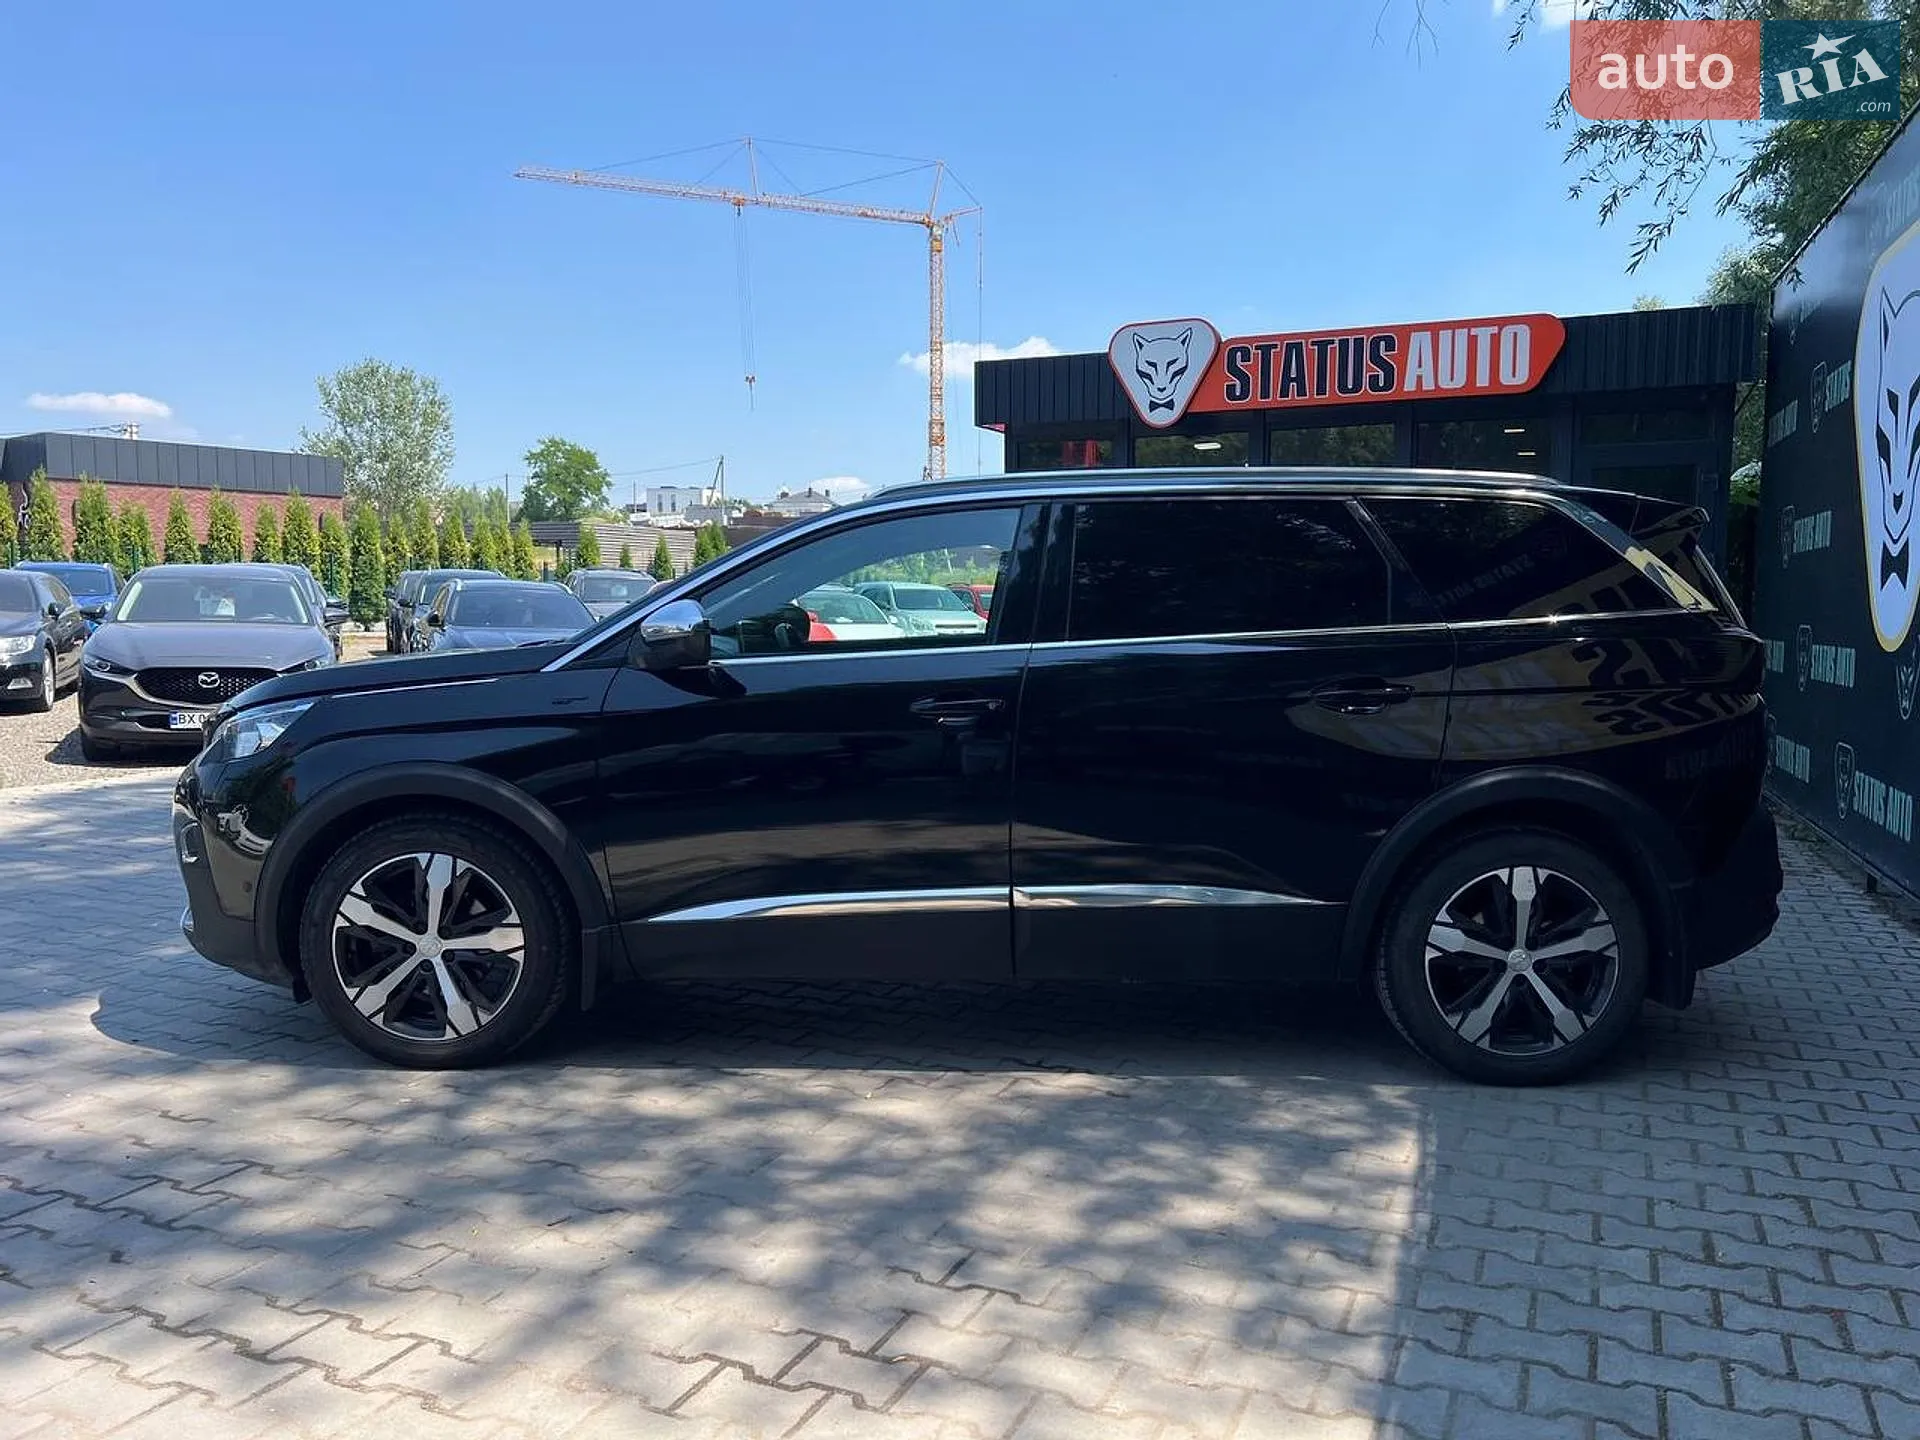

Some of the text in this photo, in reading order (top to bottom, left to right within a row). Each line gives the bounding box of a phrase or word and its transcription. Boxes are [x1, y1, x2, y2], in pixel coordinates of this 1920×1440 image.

[1224, 324, 1532, 403] STATUS AUTO
[1811, 643, 1836, 684] STATUS
[1836, 646, 1856, 688] AUTO
[1853, 770, 1913, 842] STATUS AUTO
